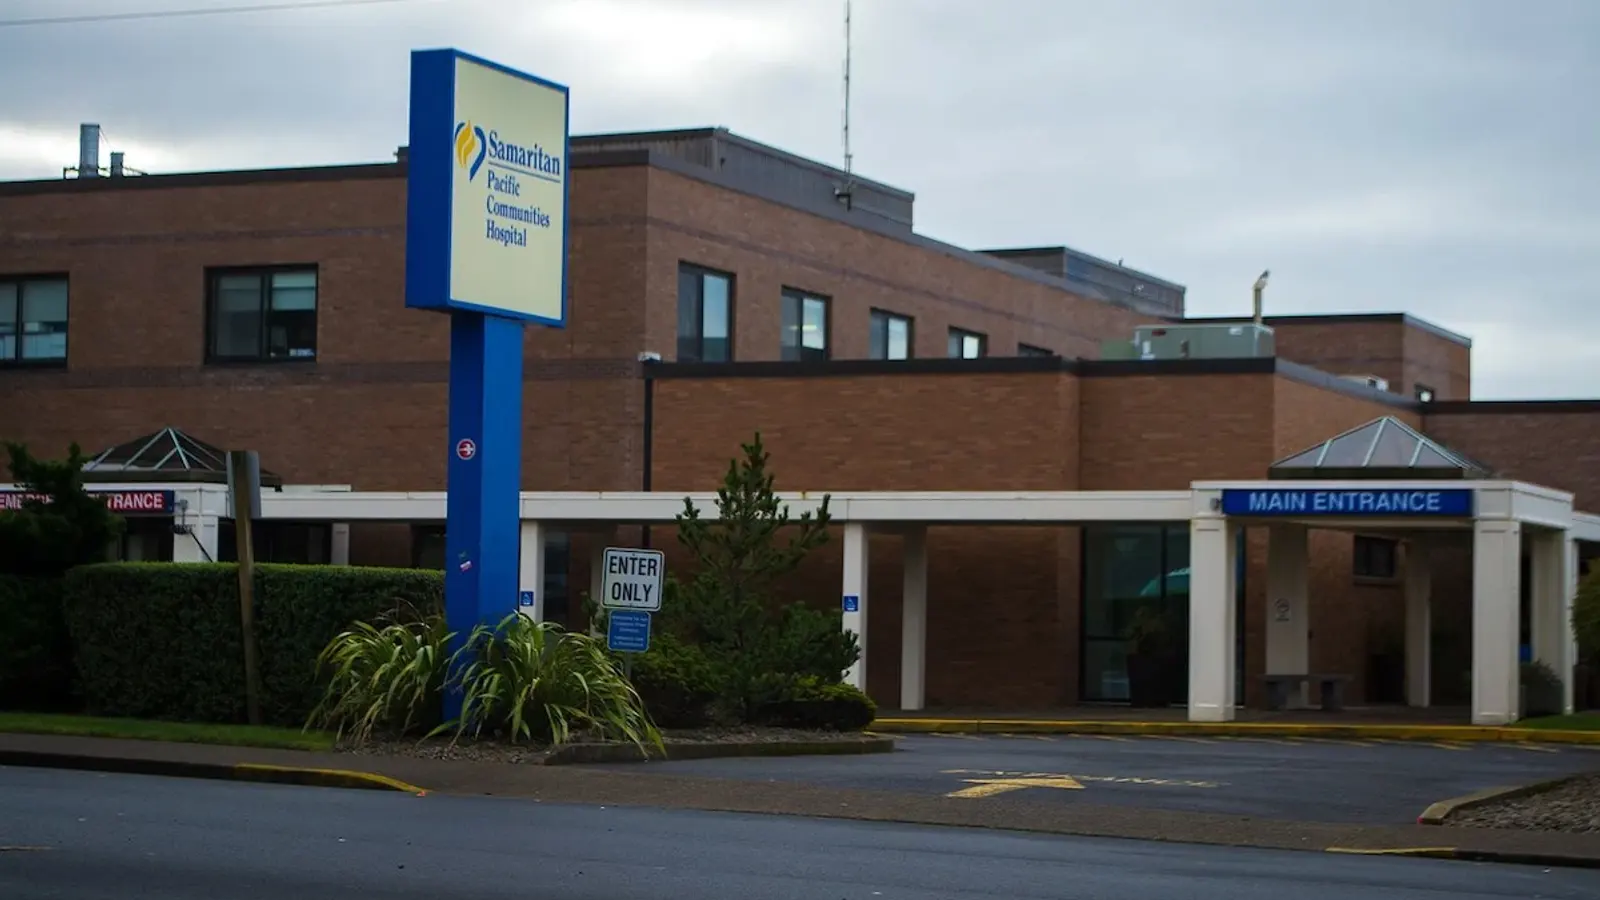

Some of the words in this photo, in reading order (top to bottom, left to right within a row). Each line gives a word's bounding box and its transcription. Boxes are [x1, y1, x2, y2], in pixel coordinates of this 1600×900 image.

[488, 129, 561, 176] Samaritan
[487, 169, 521, 196] Pacific
[486, 194, 550, 228] Communities
[486, 219, 527, 247] Hospital
[87, 493, 163, 509] TRANCE
[1250, 492, 1305, 511] MAIN
[1313, 492, 1441, 511] ENTRANCE
[609, 555, 658, 577] ENTER
[611, 582, 653, 602] ONLY
